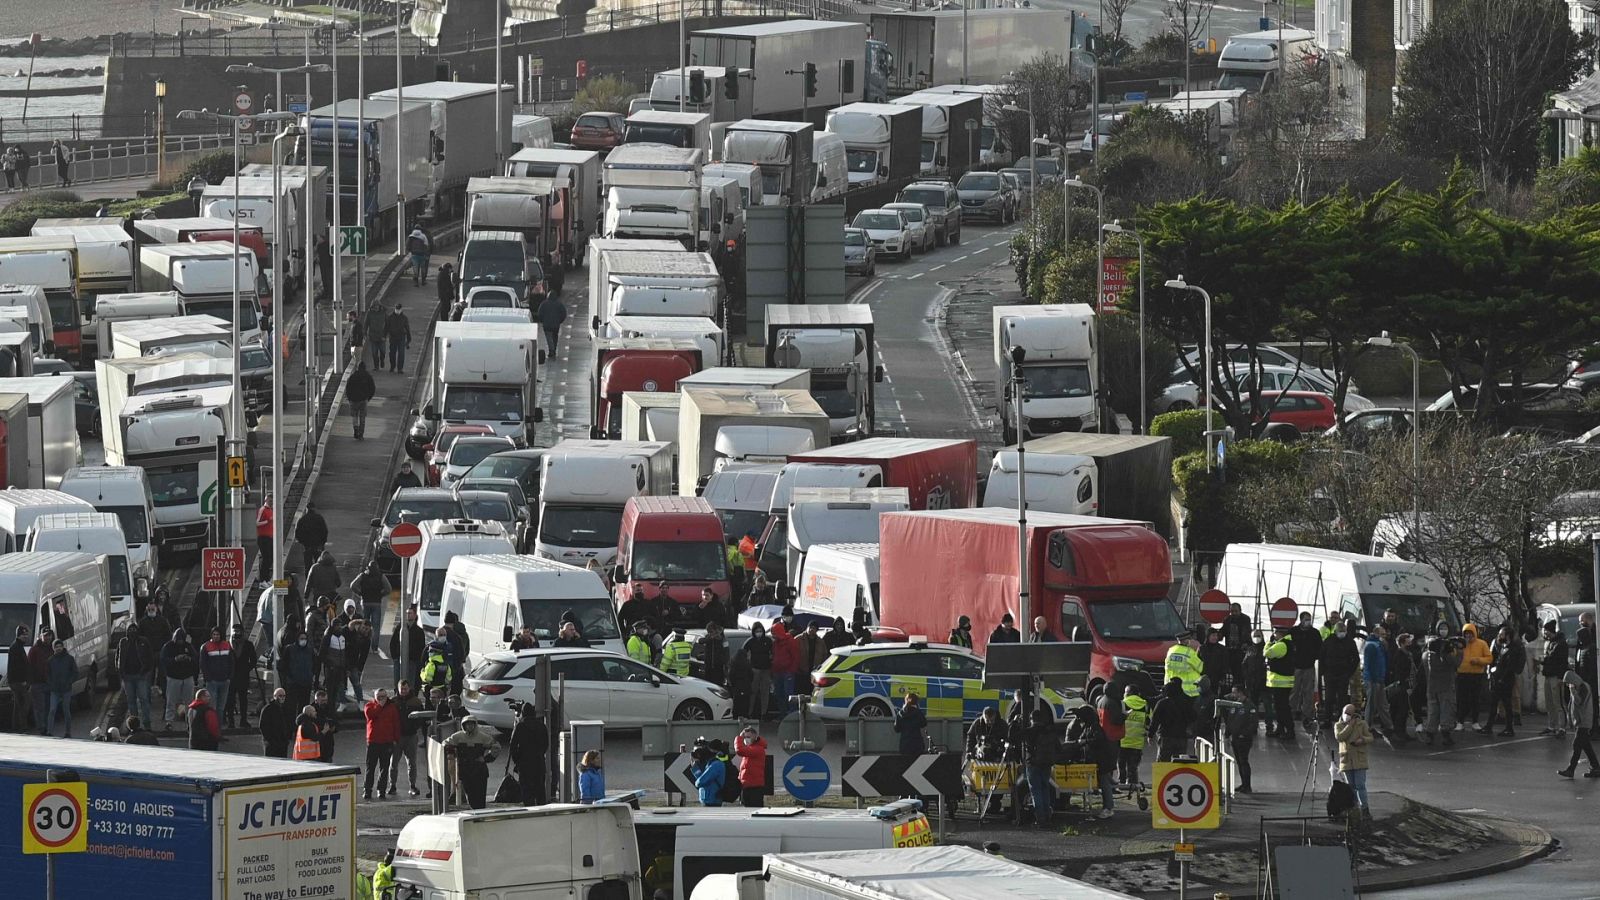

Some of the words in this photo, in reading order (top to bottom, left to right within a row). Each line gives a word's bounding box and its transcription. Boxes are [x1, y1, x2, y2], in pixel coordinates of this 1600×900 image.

[213, 551, 234, 560] NEW
[210, 560, 236, 569] ROAD
[206, 569, 241, 578] LAYOUT
[207, 578, 239, 587] AHEAD
[1166, 784, 1206, 807] 30
[133, 802, 175, 817] ARQUES
[238, 801, 266, 831] JC
[270, 793, 341, 827] FIOLET
[36, 805, 75, 830] 30
[93, 820, 112, 833] +33
[115, 821, 132, 835] 321
[135, 823, 153, 838] 987
[156, 826, 175, 839] 777
[281, 826, 337, 841] TRANSPORTS
[898, 831, 932, 848] POLICE
[311, 847, 328, 856] BULK
[243, 854, 269, 864] PACKED
[295, 859, 312, 868] FOOD
[314, 855, 345, 866] POWDERS
[237, 866, 253, 875] FULL
[254, 863, 275, 873] LOADS
[298, 869, 315, 878] FOOD
[316, 866, 342, 876] LIQUIDS
[237, 876, 253, 885] PART
[254, 873, 275, 883] LOADS
[243, 891, 262, 900] The
[264, 888, 284, 900] way
[287, 887, 297, 898] to
[300, 884, 335, 896] Europe
